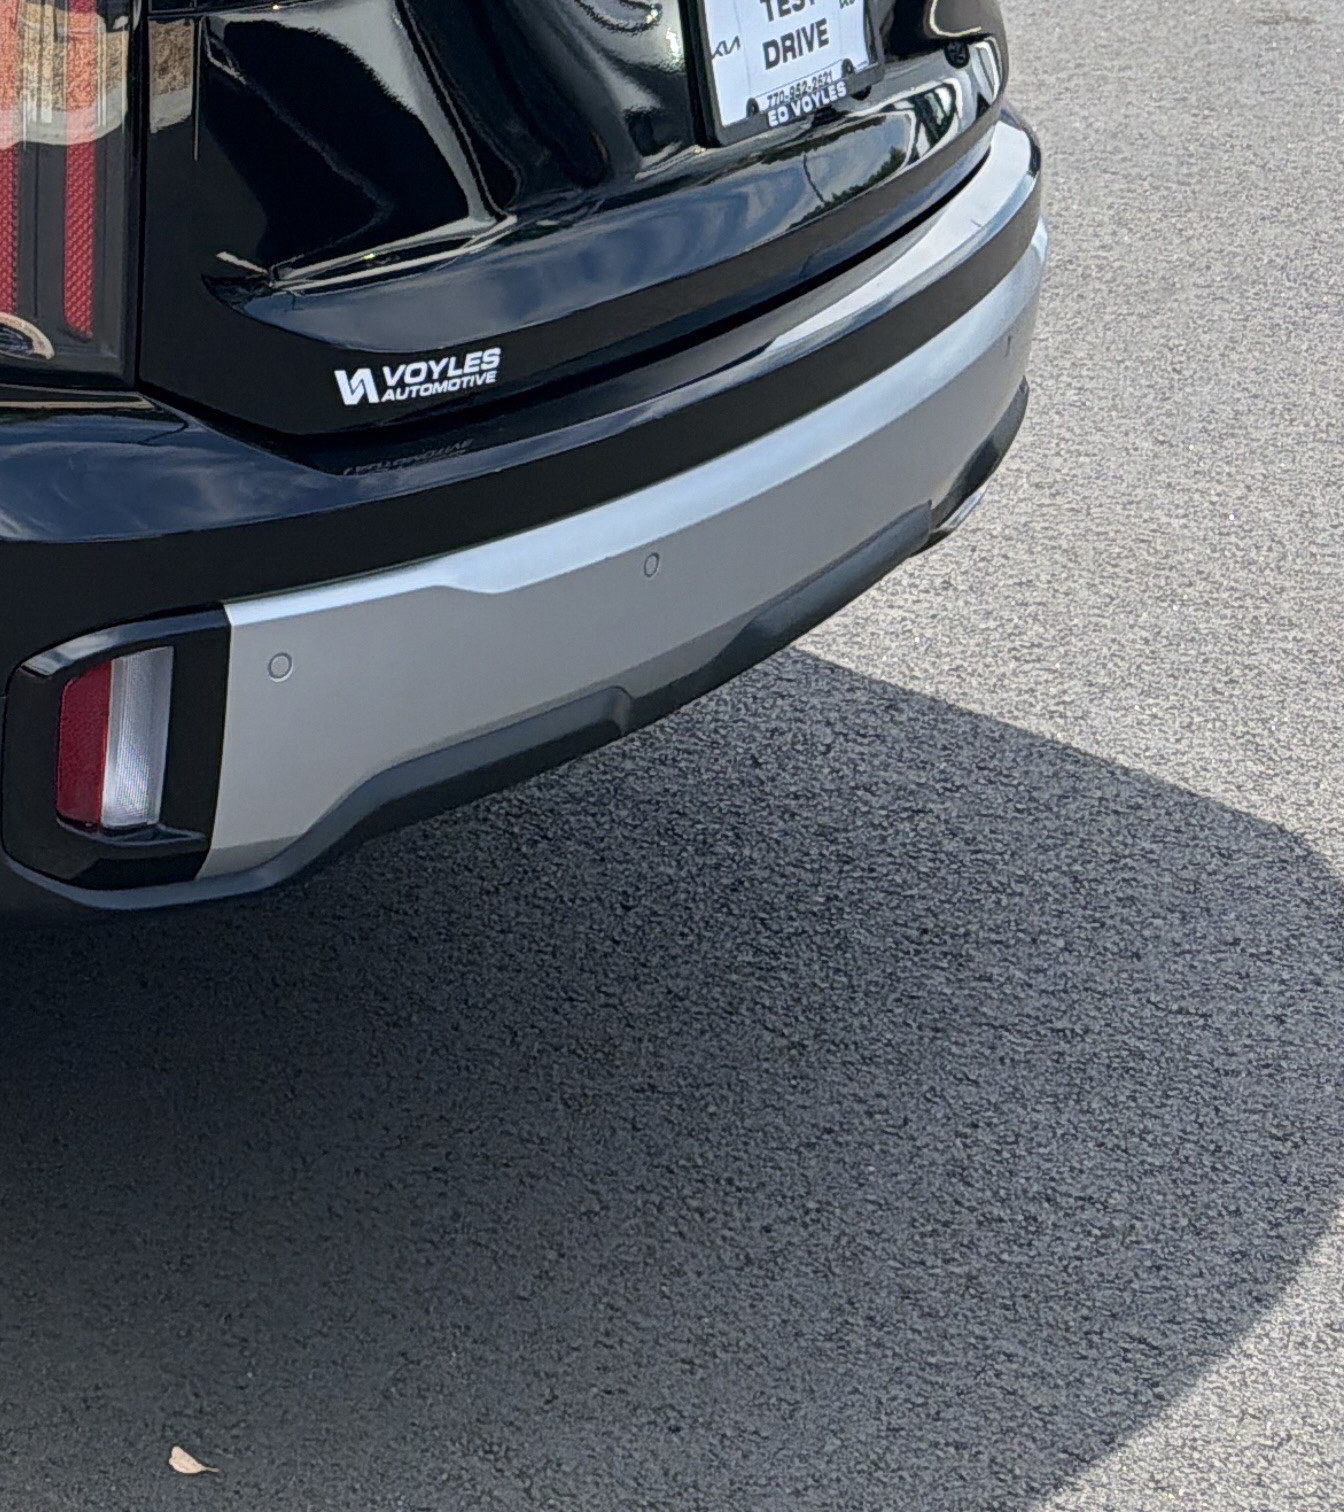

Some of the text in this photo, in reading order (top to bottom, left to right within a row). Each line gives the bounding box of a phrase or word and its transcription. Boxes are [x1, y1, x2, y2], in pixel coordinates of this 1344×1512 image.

[762, 17, 829, 70] DRIVE
[768, 81, 847, 127] ED VOYLES
[381, 347, 501, 387] VOYLES
[381, 370, 497, 403] AUTOMOTIVE
